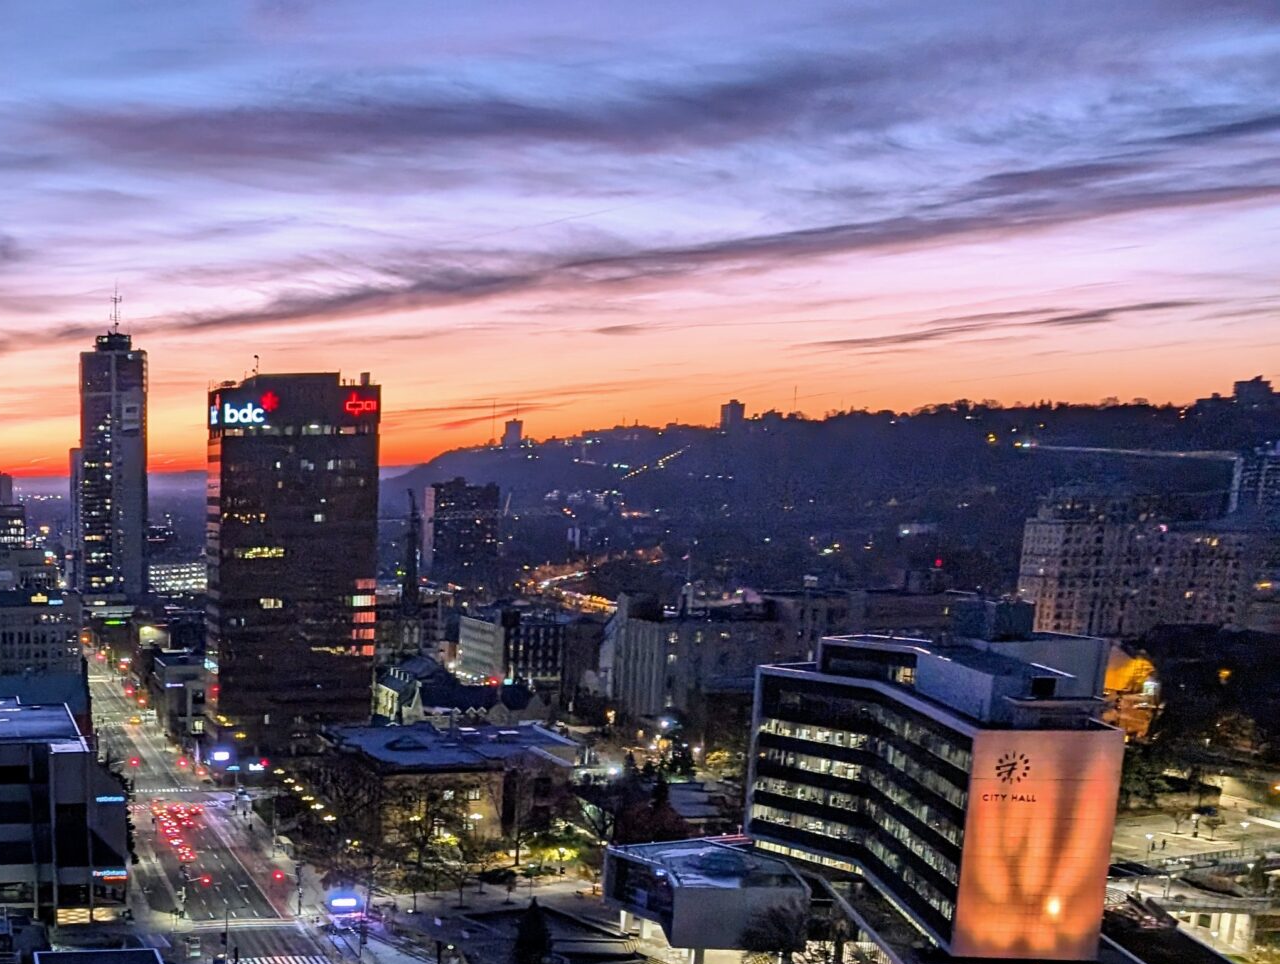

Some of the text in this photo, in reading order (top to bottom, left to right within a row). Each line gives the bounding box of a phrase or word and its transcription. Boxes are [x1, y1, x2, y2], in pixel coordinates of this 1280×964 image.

[224, 402, 265, 423] bdc
[982, 793, 1037, 803] CITY HALL
